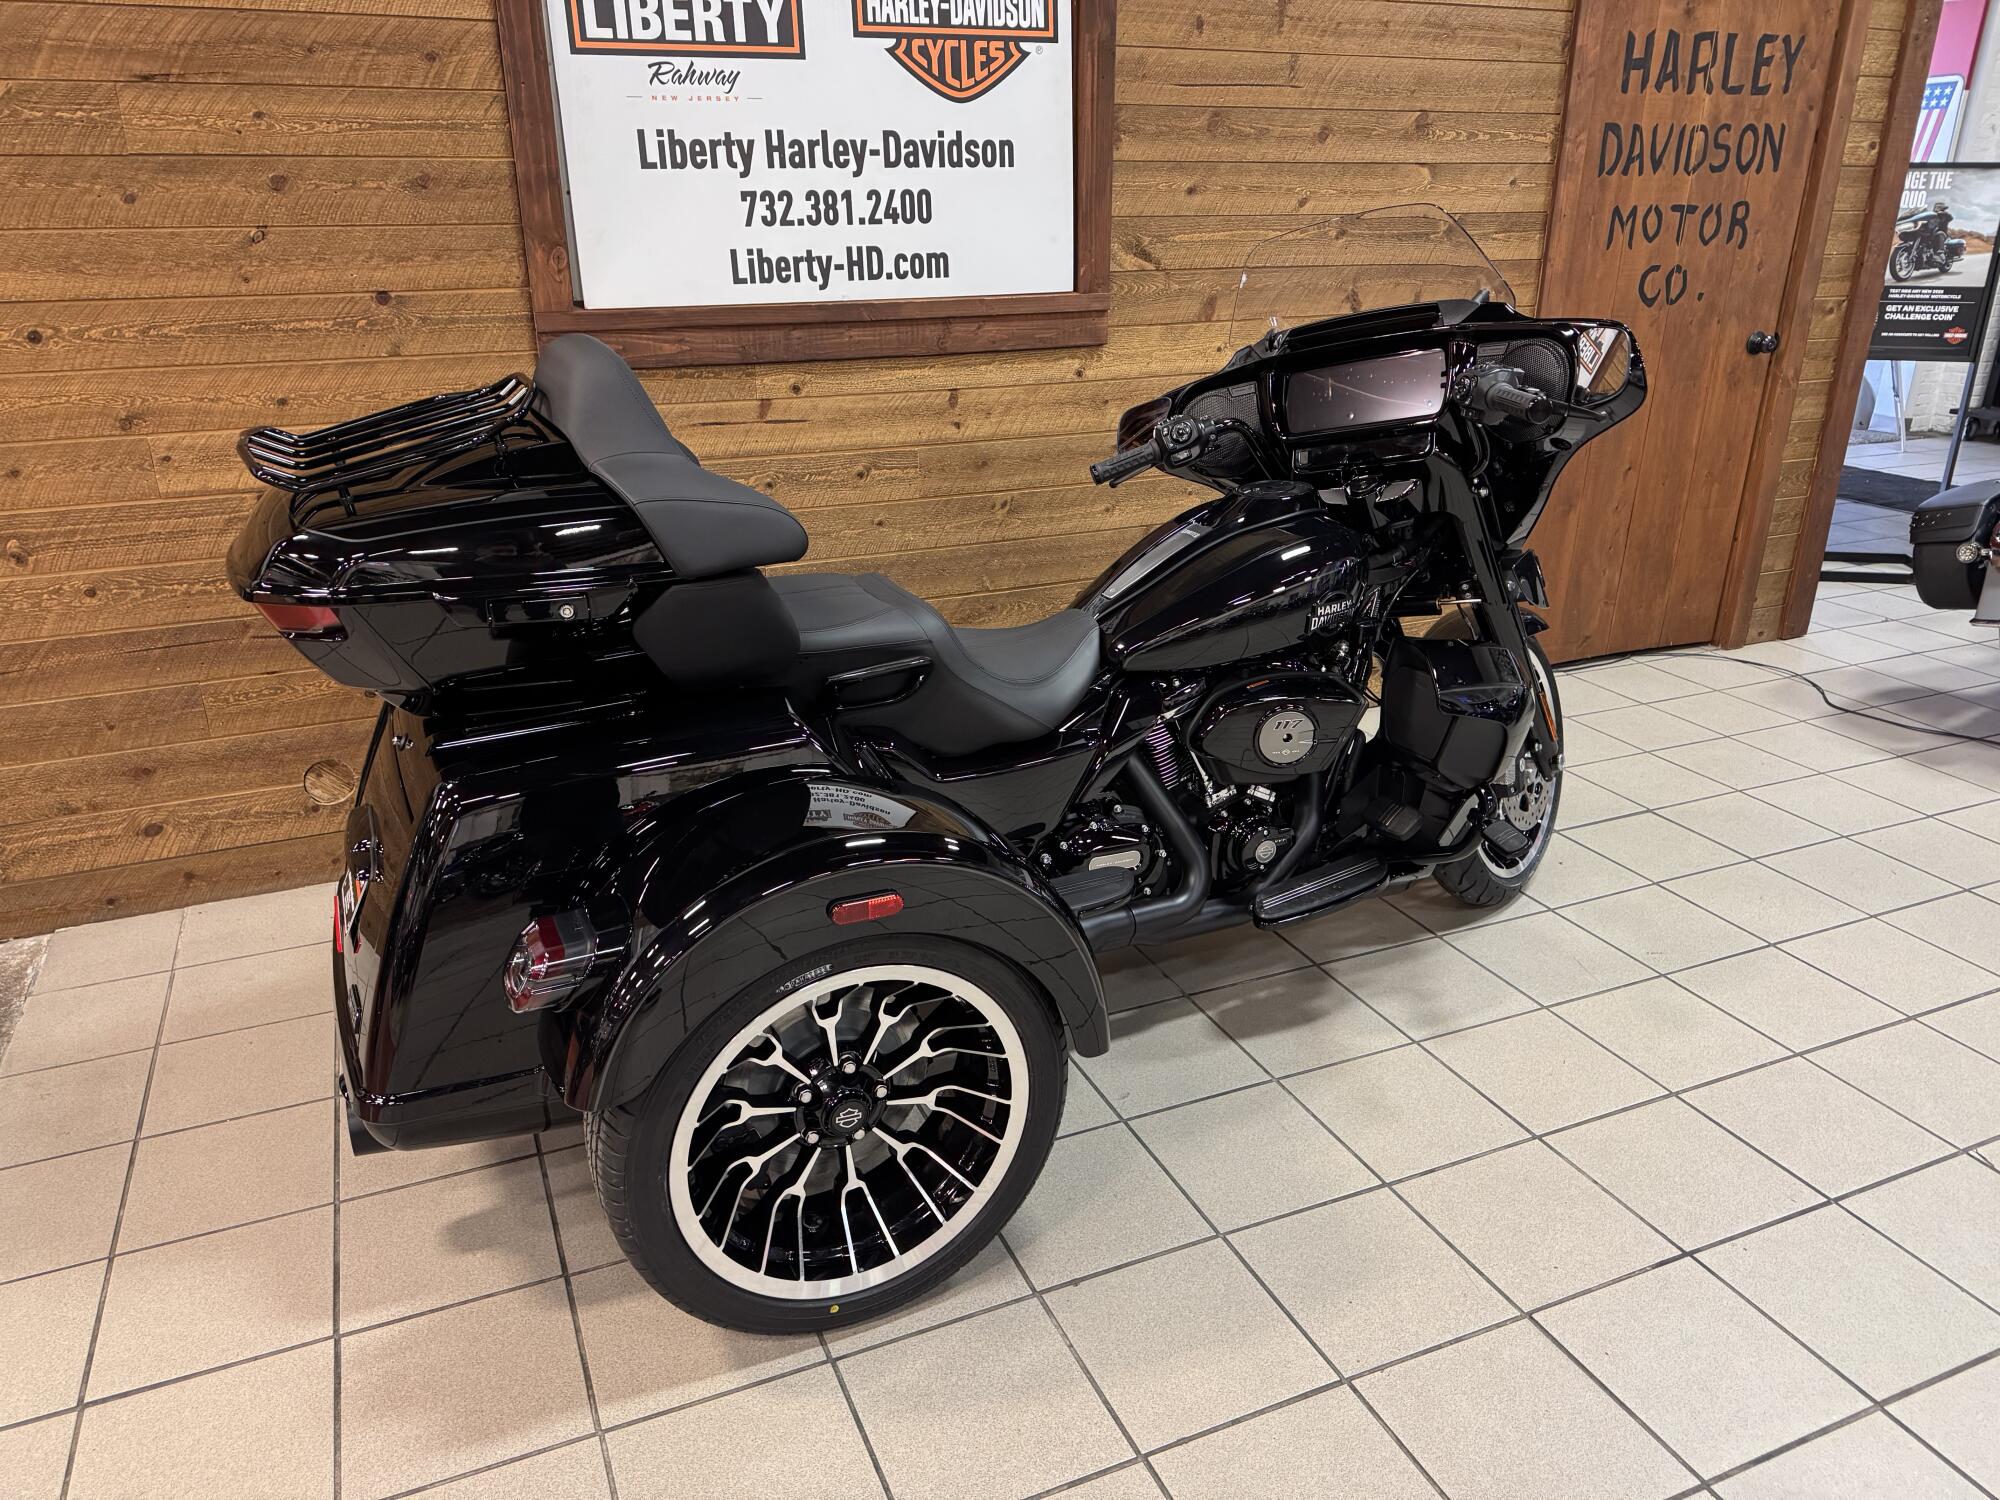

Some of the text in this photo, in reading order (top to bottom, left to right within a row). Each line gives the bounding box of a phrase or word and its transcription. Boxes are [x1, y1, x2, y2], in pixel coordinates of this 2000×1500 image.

[583, 0, 784, 43] LIBERTY
[867, 0, 1045, 28] HARLEY-DAVIDSON
[647, 60, 742, 94] Rahway
[911, 38, 1006, 89] CYCLES
[1621, 29, 1806, 96] HARLEY
[637, 128, 1015, 178] Liberty Harley-Davidson
[1598, 122, 1786, 177] DAVIDSON
[1900, 190, 1928, 209] QUO.
[1904, 171, 1954, 190] NGE THE
[740, 188, 932, 227] 732.381.2400
[1606, 200, 1750, 250] MOTOR
[730, 245, 950, 291] Liberty-HD.com
[1638, 263, 1705, 308] CO.
[1884, 312, 1932, 320] CHALLENGE
[1885, 304, 1903, 312] GET
[1915, 305, 1960, 313] EXCLUSIVE
[1317, 599, 1352, 616] HARLEY
[1274, 719, 1304, 730] 117
